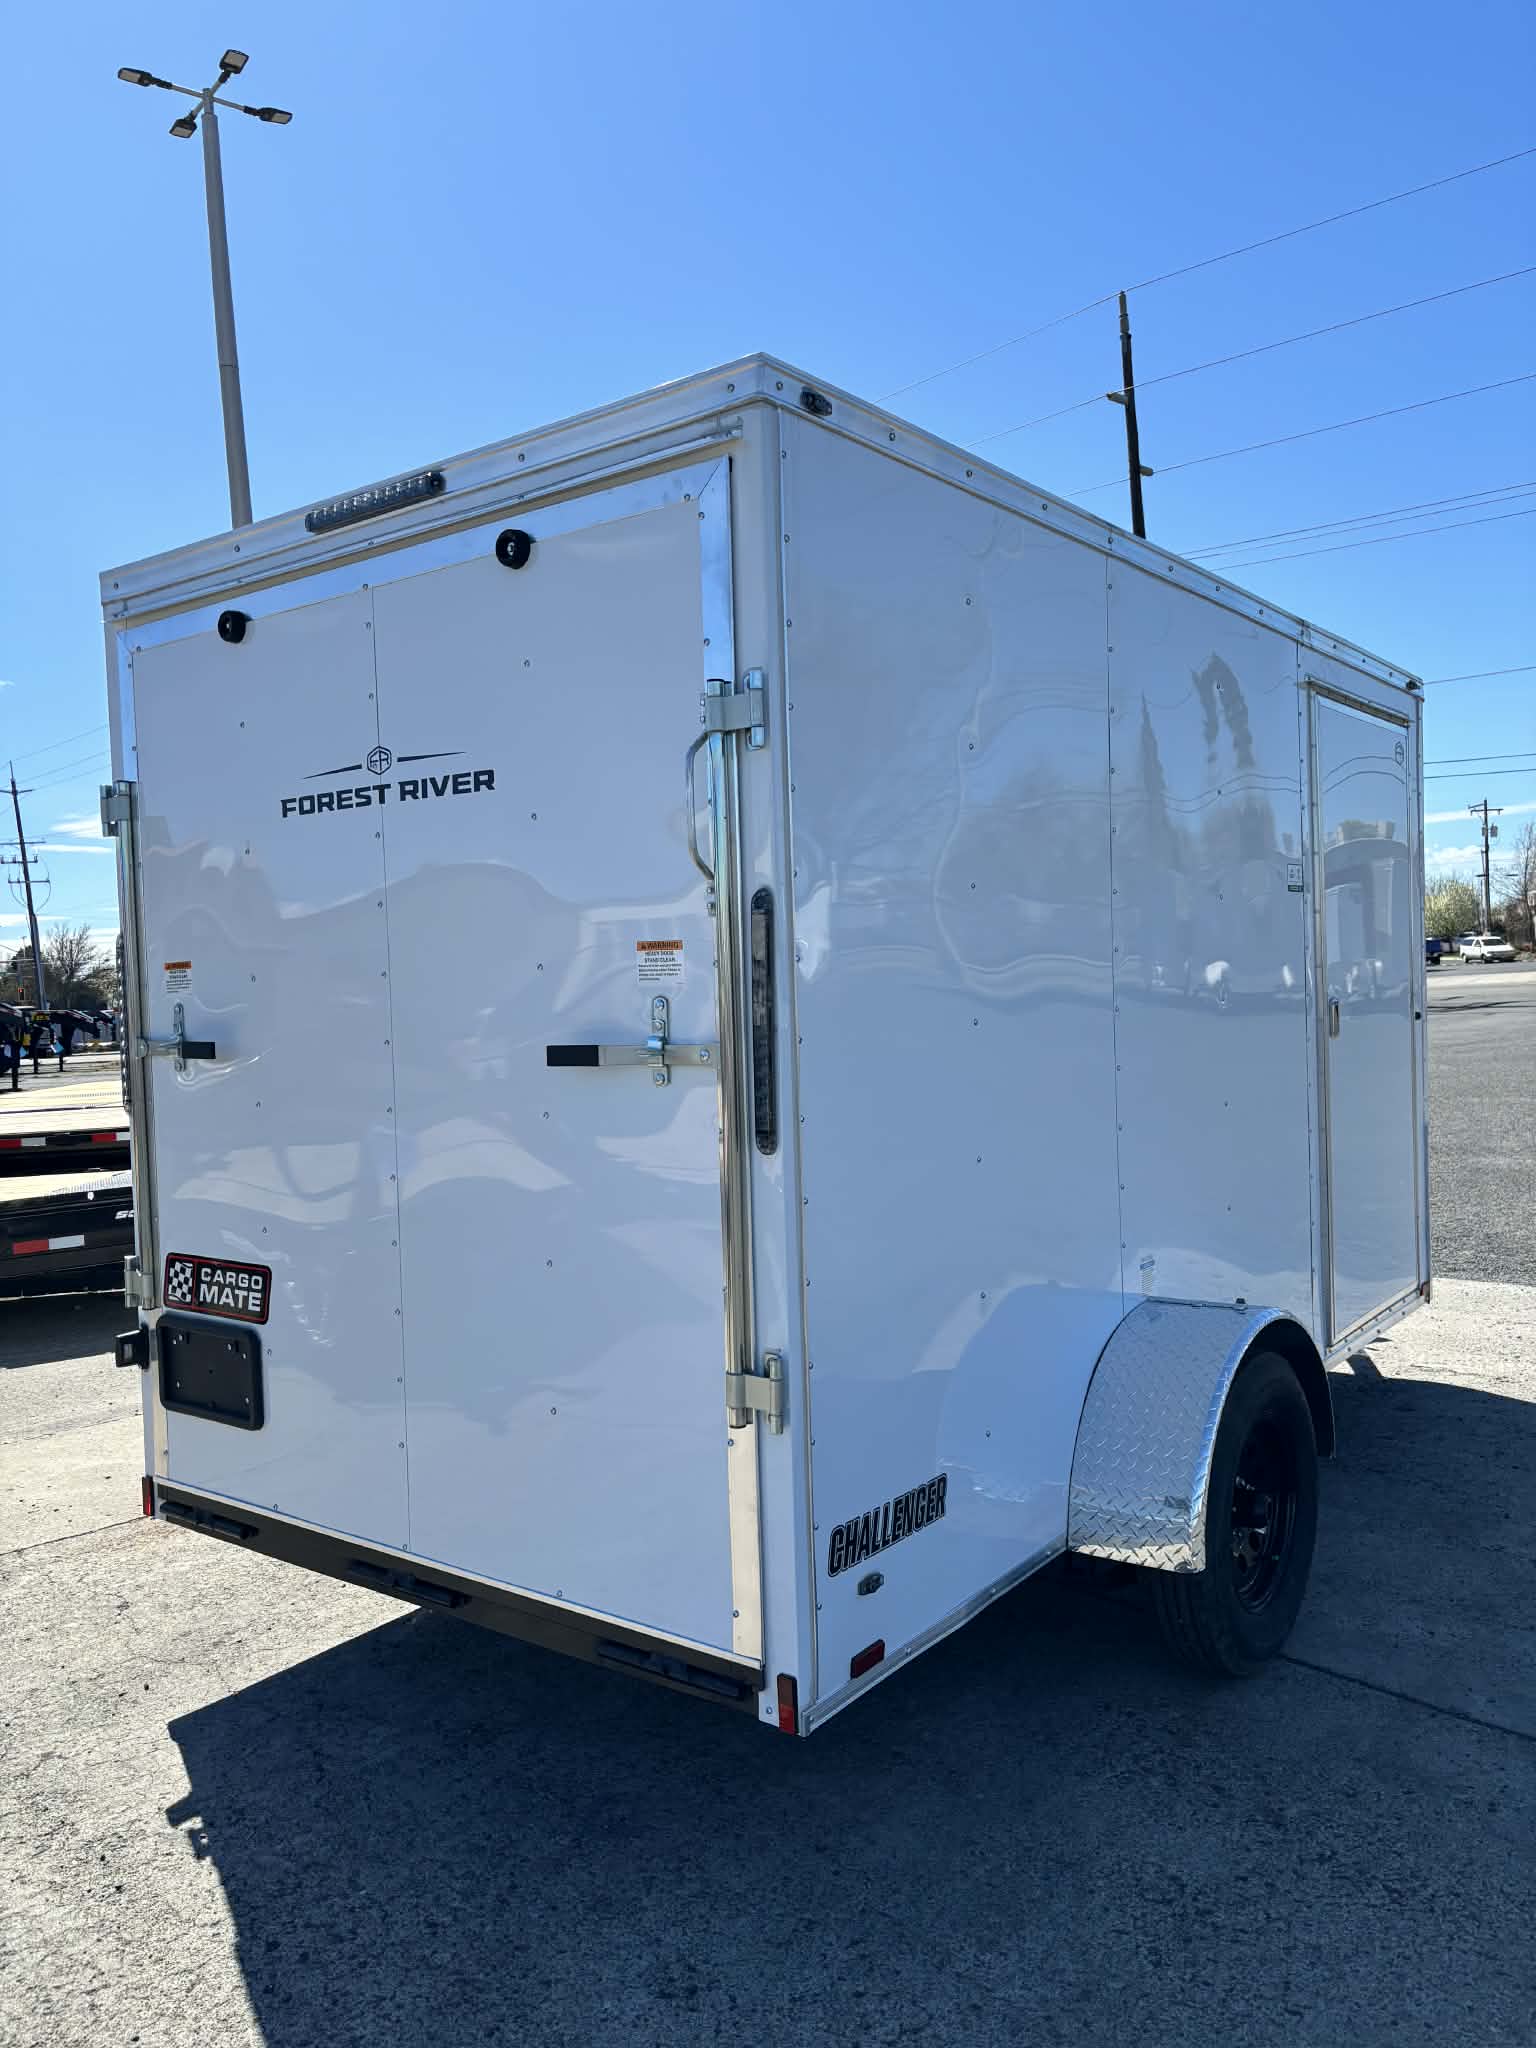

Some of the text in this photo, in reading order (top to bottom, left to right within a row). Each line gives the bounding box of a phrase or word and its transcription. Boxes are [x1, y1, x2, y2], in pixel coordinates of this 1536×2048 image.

[280, 768, 496, 819] FOREST RIVER
[199, 1283, 263, 1312] MATE
[200, 1267, 264, 1290] CARGO
[828, 1473, 948, 1578] CHALLENGER
